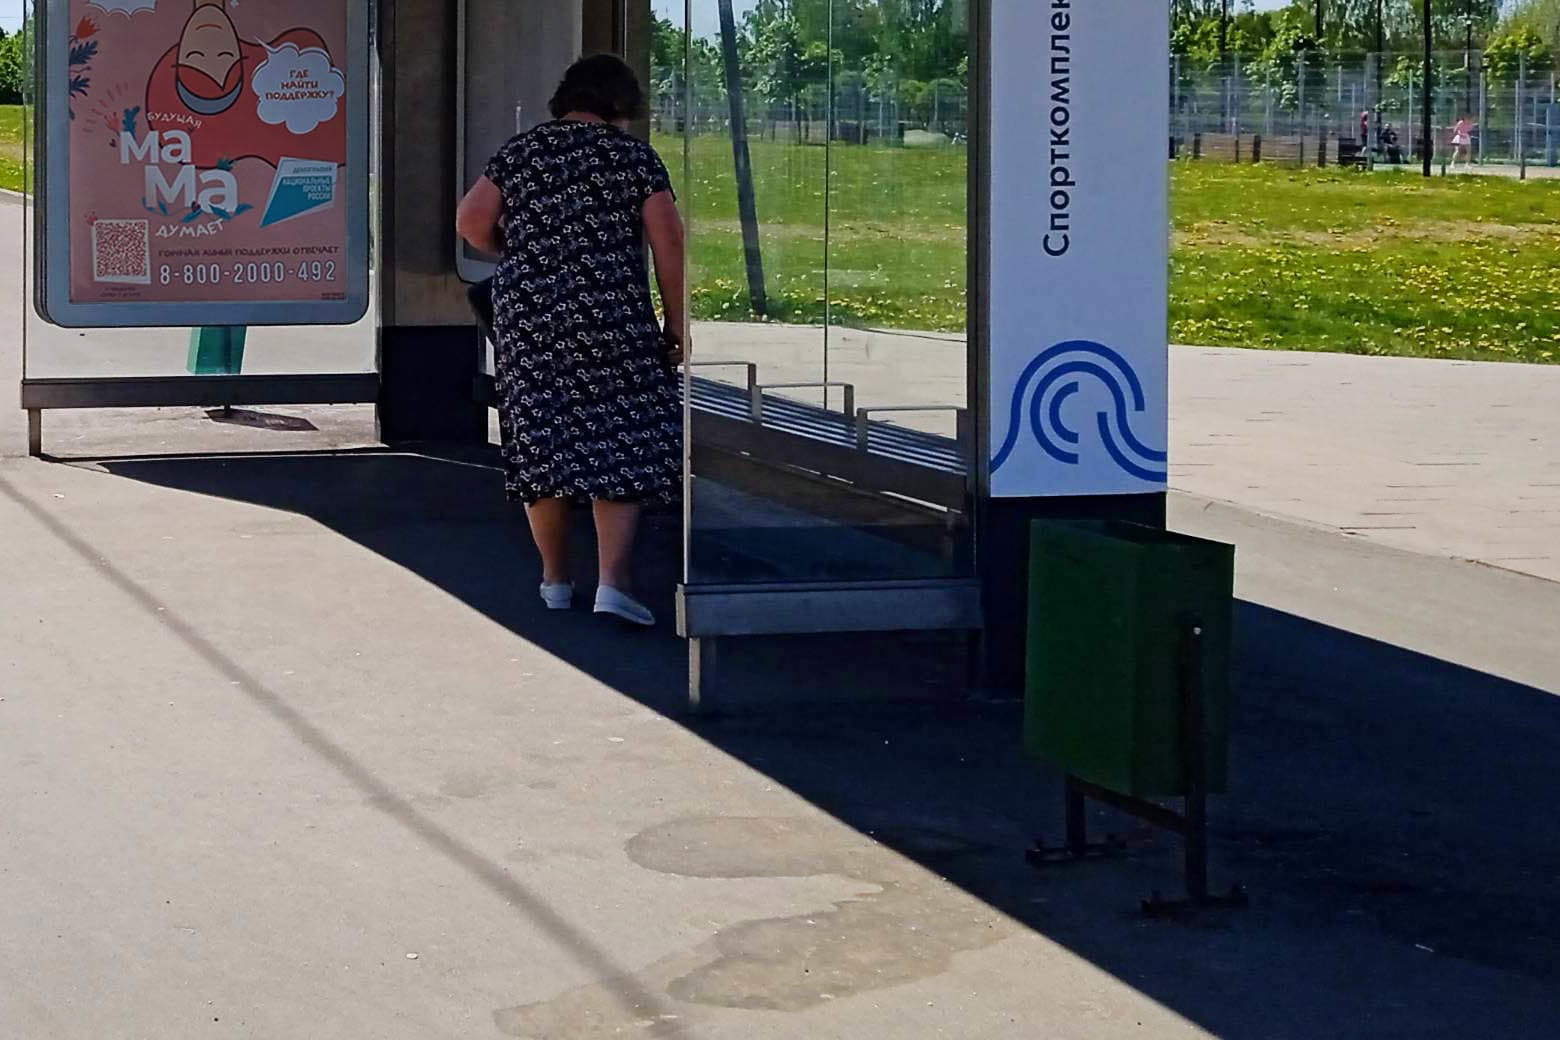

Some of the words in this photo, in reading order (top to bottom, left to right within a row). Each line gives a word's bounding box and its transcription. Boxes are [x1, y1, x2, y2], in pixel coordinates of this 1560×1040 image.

[289, 69, 309, 79] ГДЕ
[281, 79, 318, 89] НАЙТИ
[155, 218, 224, 238] ДУМАЕТ
[159, 260, 336, 285] 8-800-2000-492
